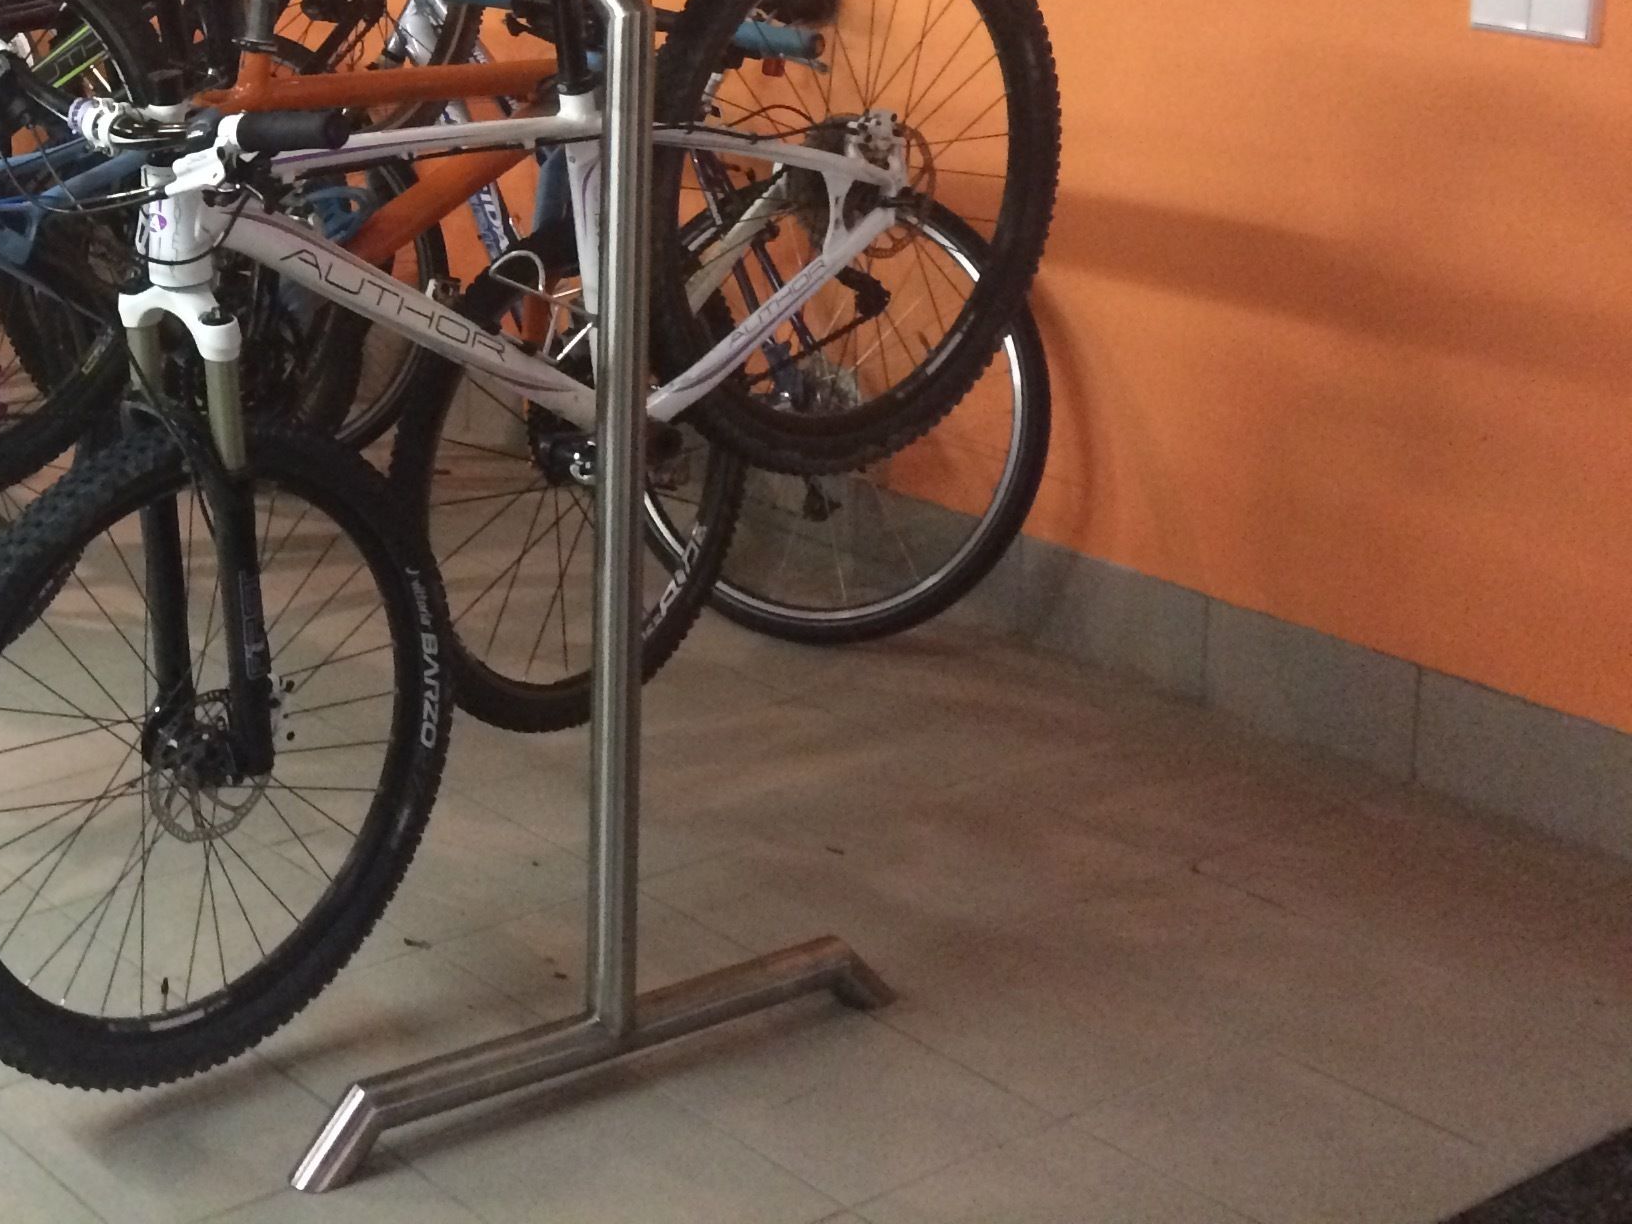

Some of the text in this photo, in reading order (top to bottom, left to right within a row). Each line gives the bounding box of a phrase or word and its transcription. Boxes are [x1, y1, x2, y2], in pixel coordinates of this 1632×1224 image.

[279, 248, 506, 362] AUTHOR
[729, 259, 825, 347] AUTHOR
[420, 631, 440, 750] BARZO
